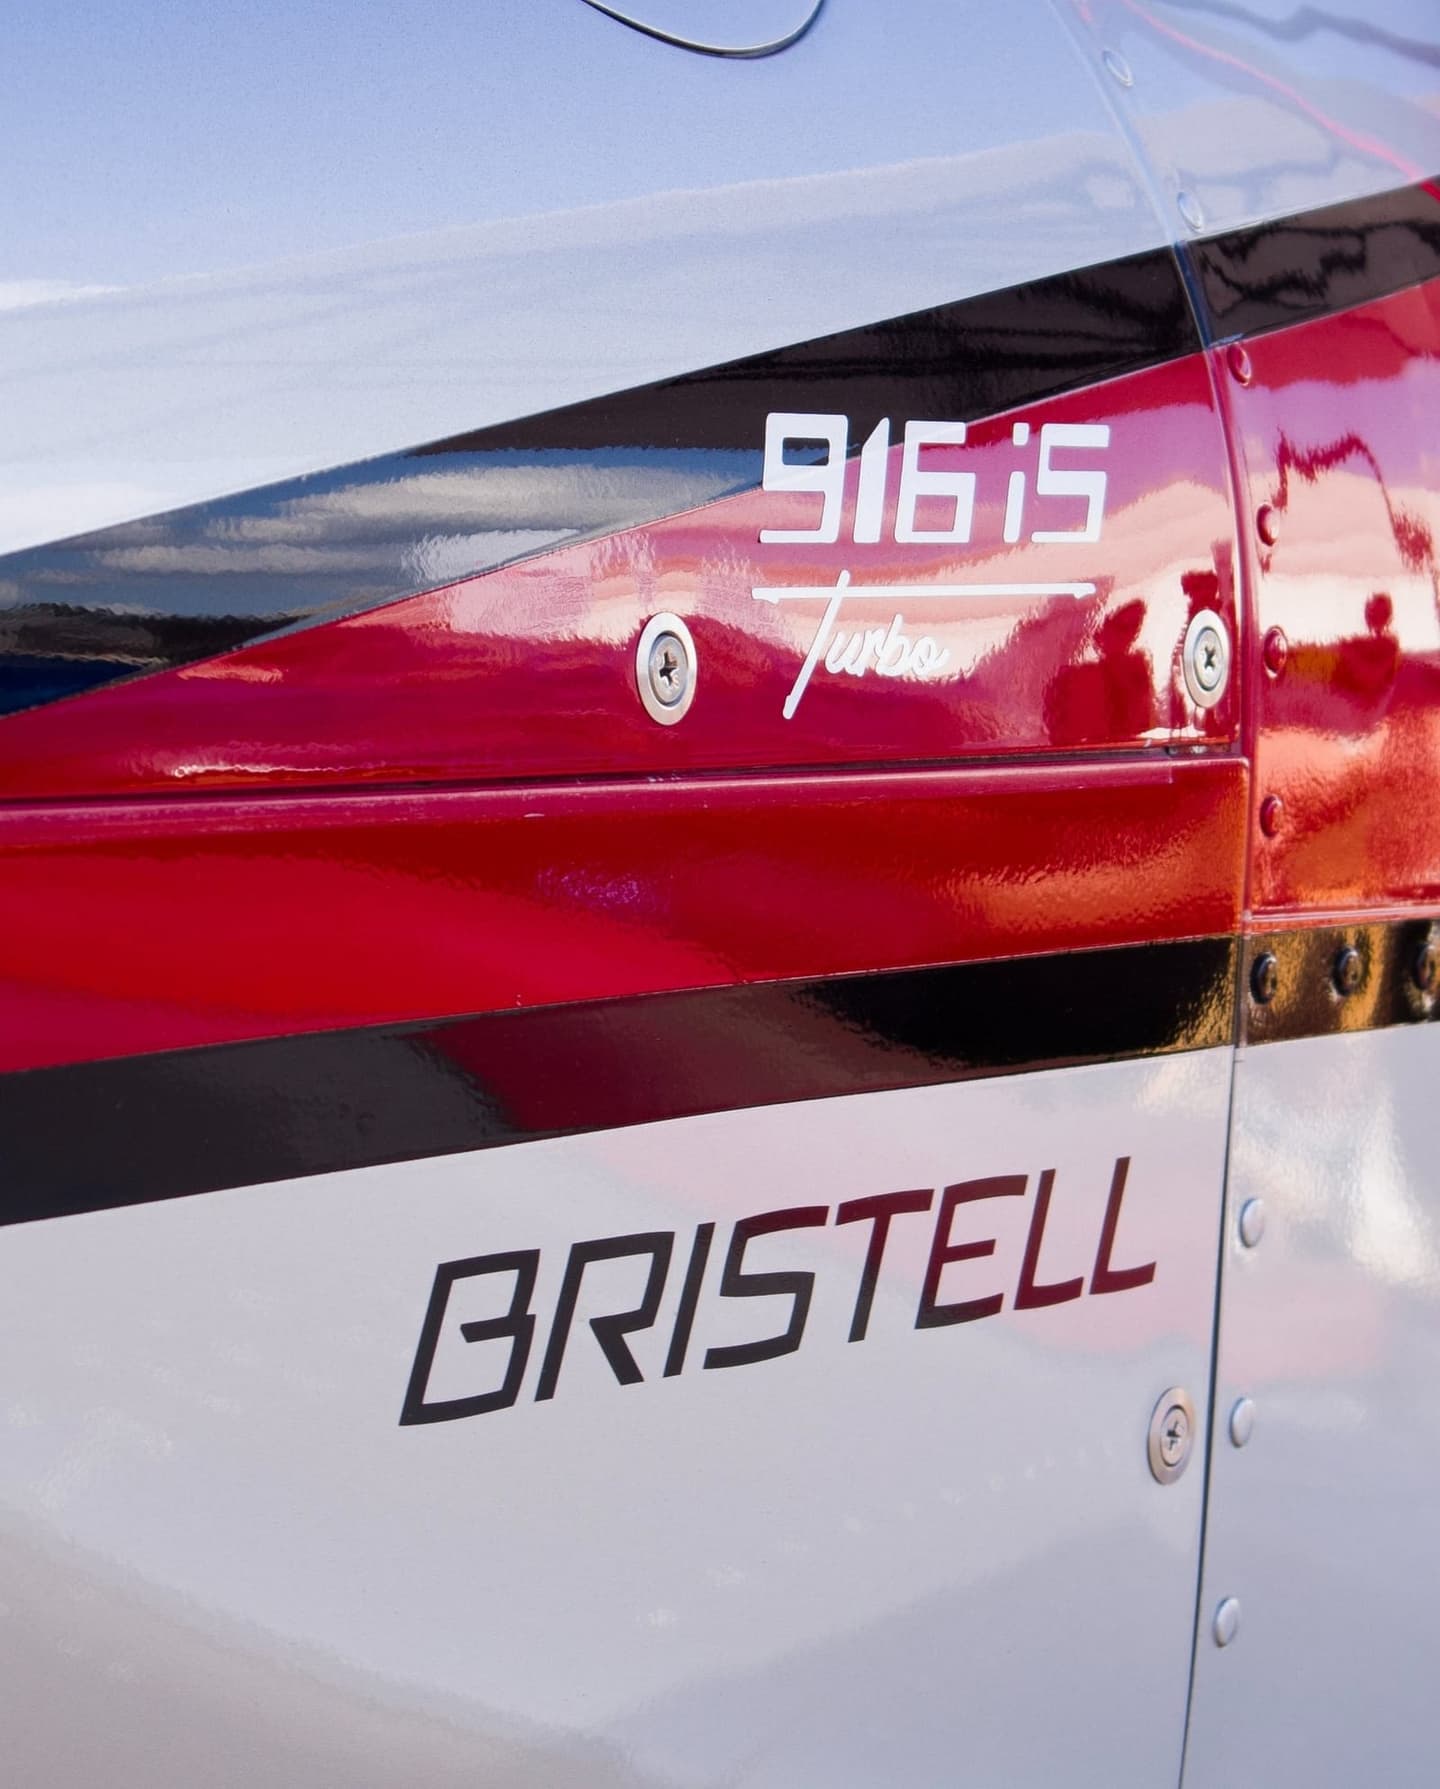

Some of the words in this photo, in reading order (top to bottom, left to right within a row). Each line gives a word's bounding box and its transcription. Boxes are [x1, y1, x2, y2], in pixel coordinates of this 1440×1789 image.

[759, 412, 976, 544] 916
[751, 569, 1097, 720] Turbo
[399, 1156, 1157, 1427] BRISTELL
